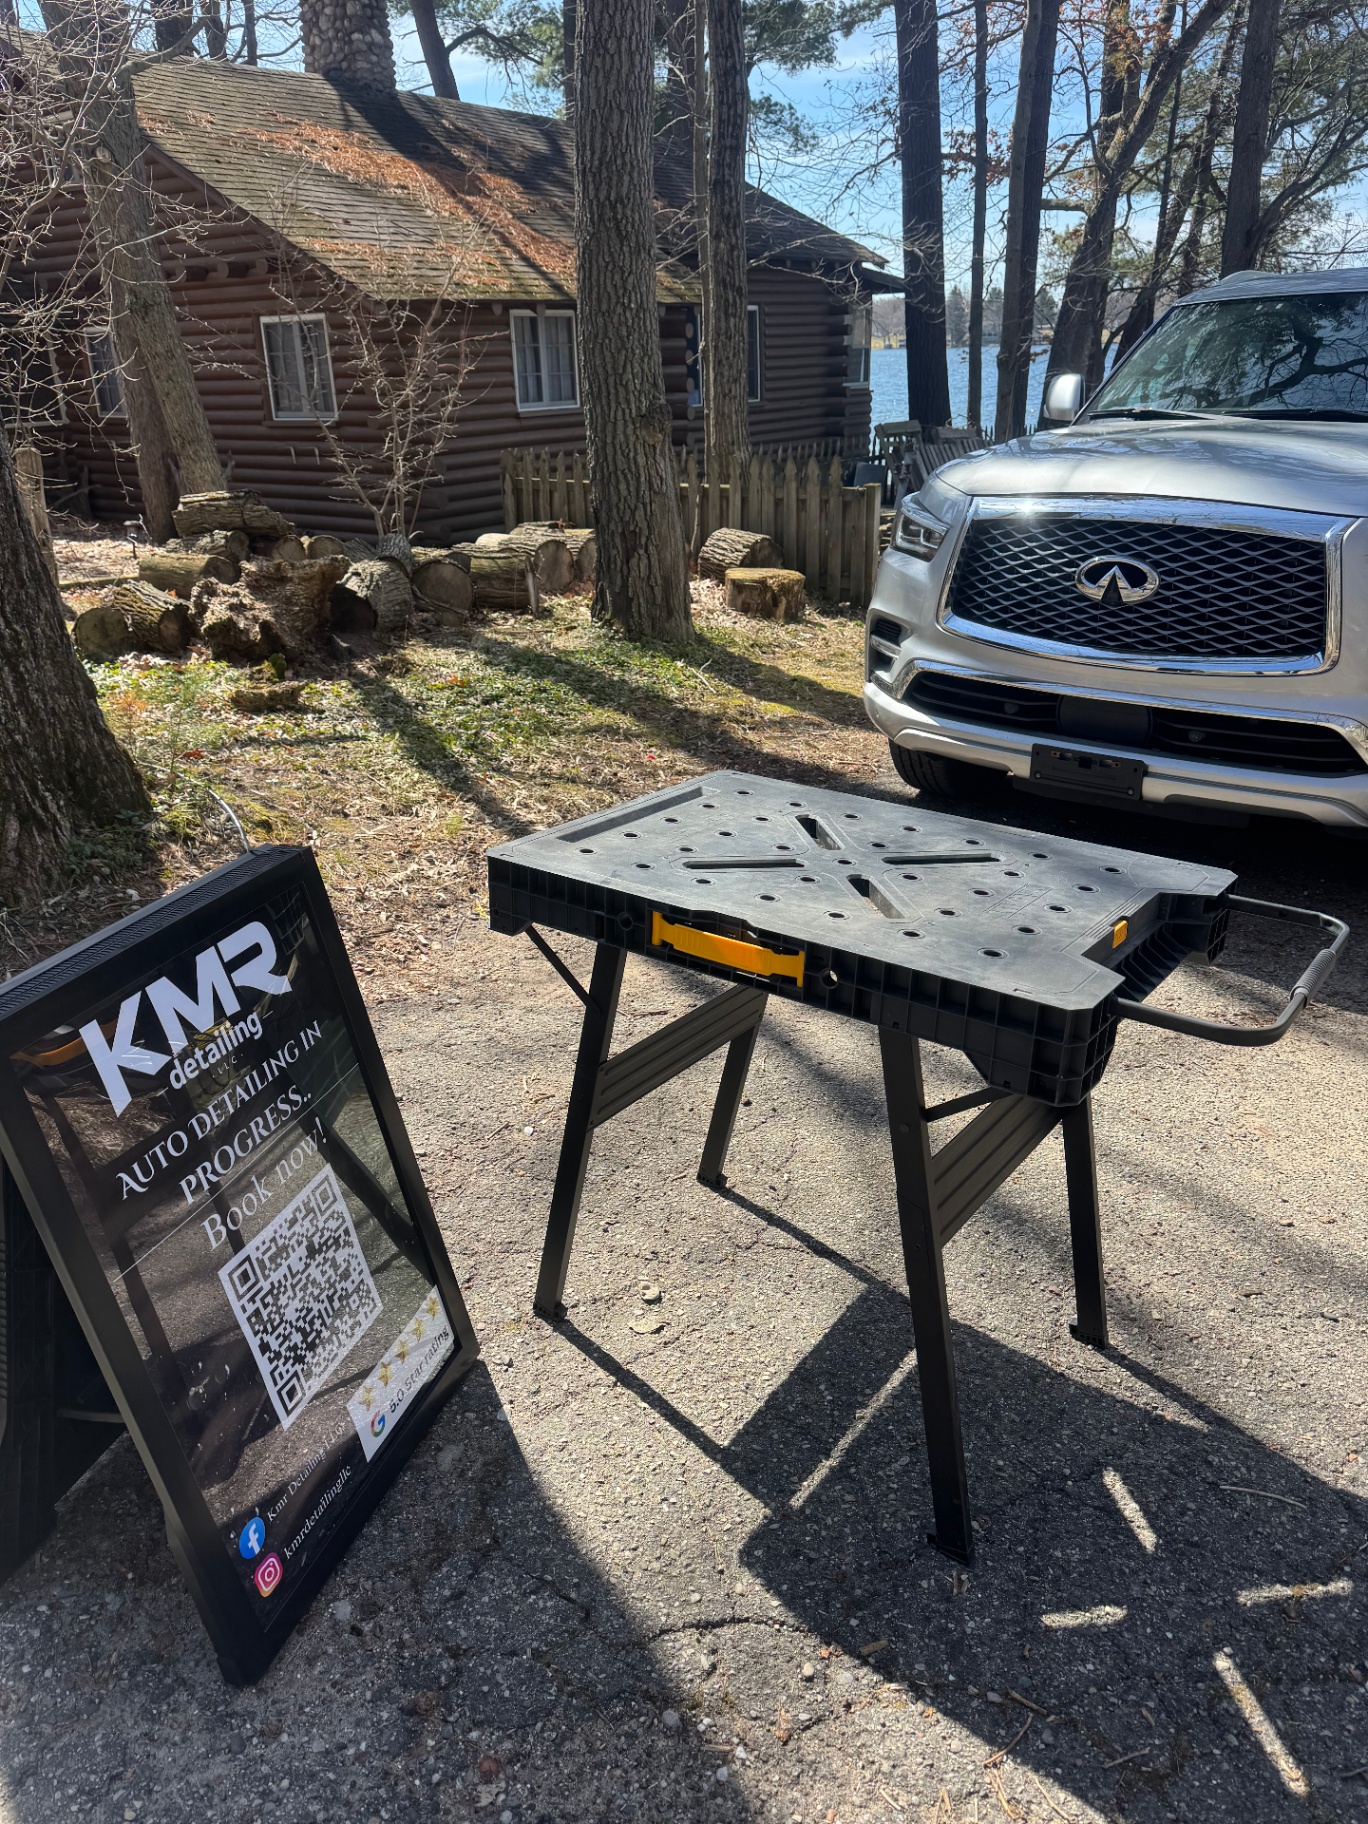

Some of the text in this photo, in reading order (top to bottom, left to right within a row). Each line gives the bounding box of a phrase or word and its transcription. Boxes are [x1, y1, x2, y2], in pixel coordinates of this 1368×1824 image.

[79, 921, 292, 1118] KMR
[169, 1011, 263, 1090] detailing
[115, 1021, 322, 1200] AUTO DETAILING IN
[201, 1116, 327, 1251] Book now!
[389, 1389, 404, 1413] 5.0
[424, 1325, 449, 1365] rating
[267, 1494, 288, 1521] Kmr
[287, 1449, 326, 1495] Detailing
[283, 1465, 351, 1560] kmrdetailingllc
